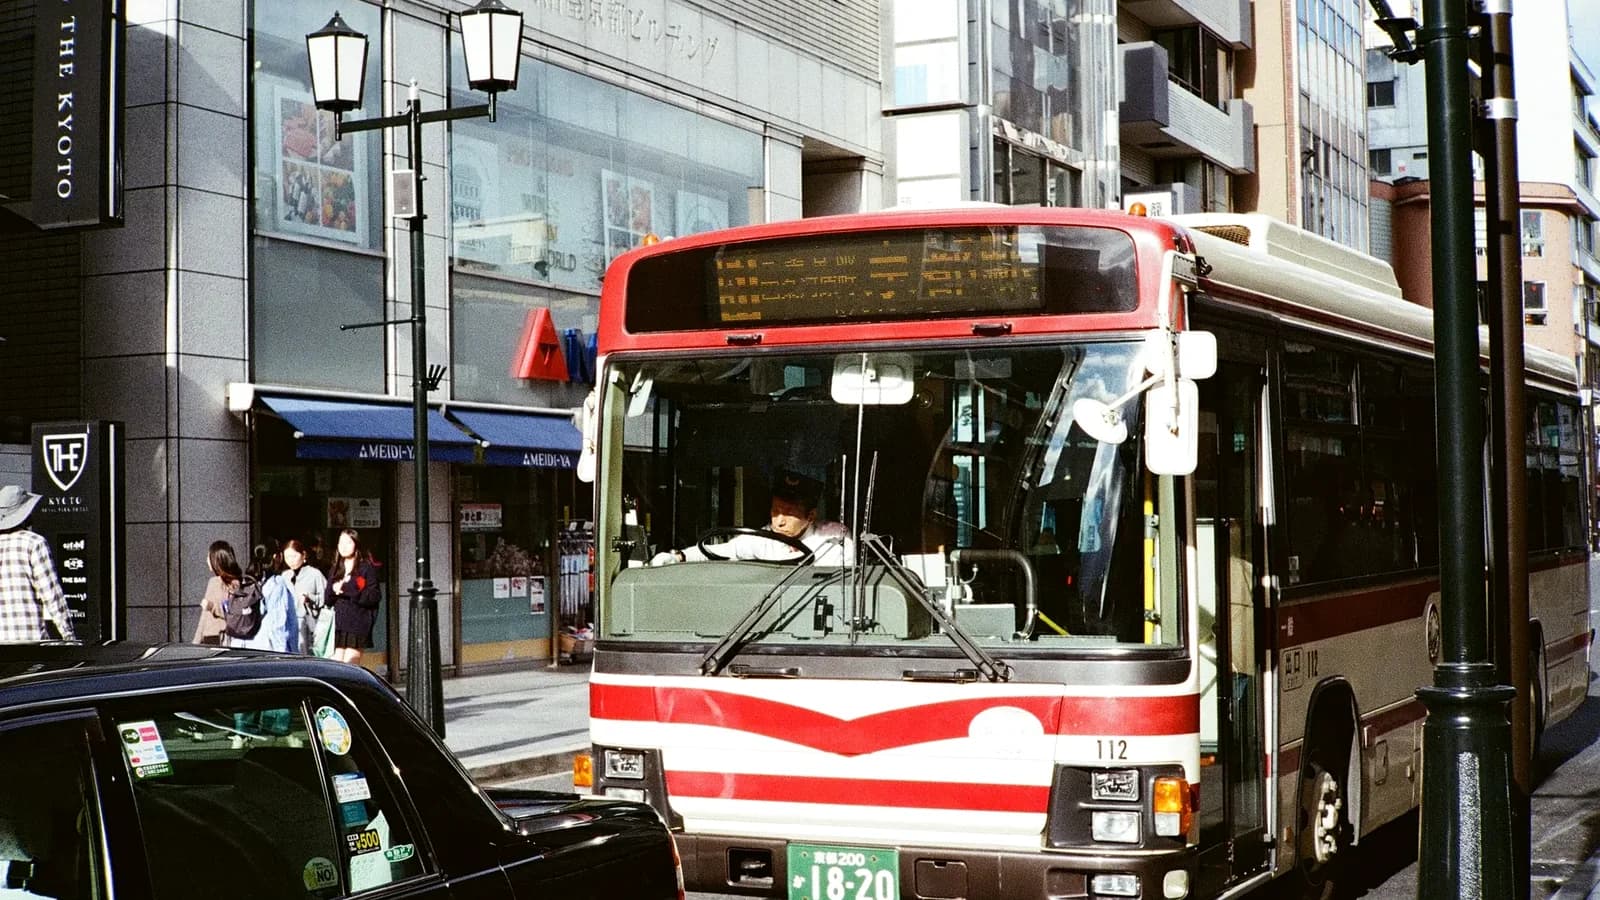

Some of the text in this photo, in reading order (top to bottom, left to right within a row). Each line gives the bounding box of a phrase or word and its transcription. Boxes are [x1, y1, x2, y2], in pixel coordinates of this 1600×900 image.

[57, 15, 75, 199] THE KYOTO
[49, 443, 82, 472] THE
[369, 444, 415, 460] MEIDI-Y
[48, 496, 82, 505] KYOTO
[1307, 649, 1318, 679] 112
[1097, 739, 1128, 760] 112
[811, 864, 895, 900] 18-20
